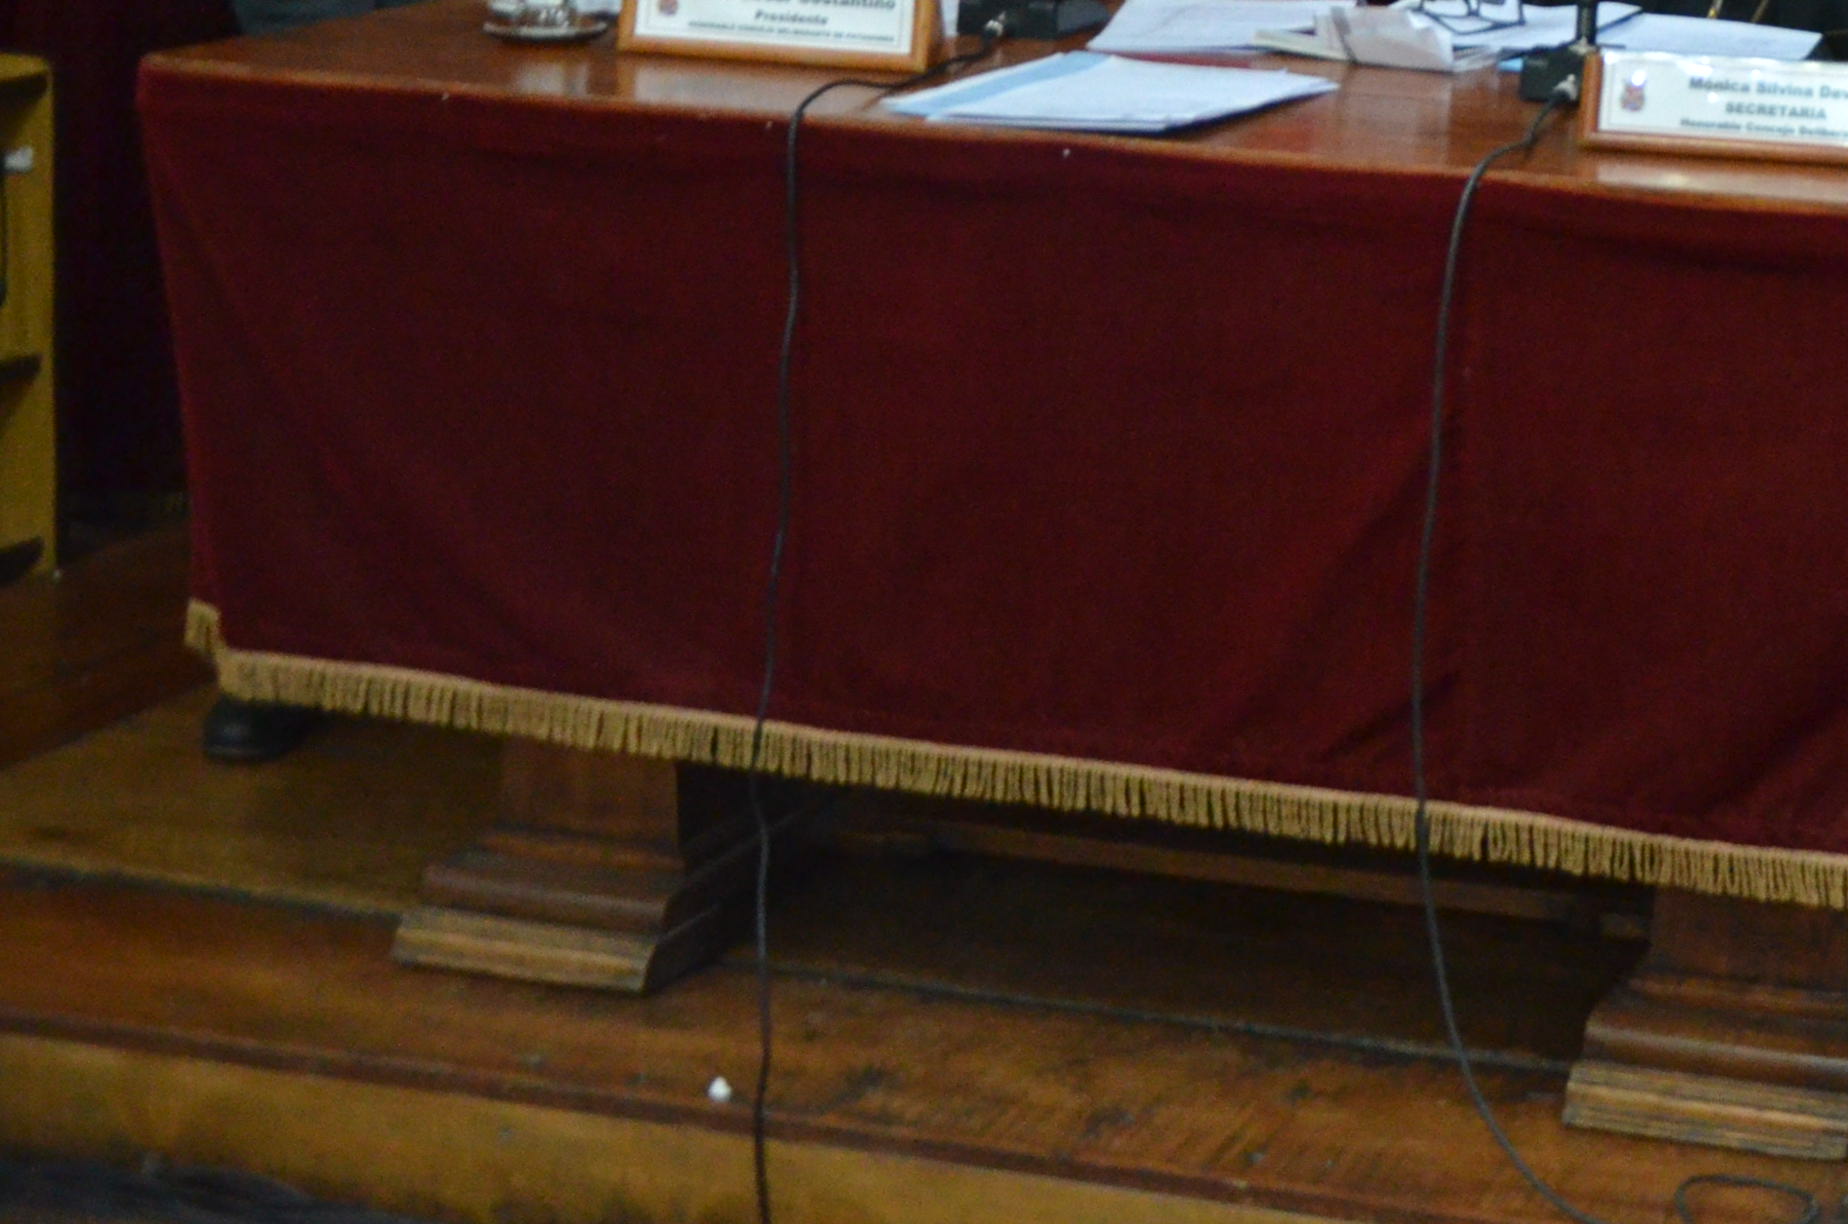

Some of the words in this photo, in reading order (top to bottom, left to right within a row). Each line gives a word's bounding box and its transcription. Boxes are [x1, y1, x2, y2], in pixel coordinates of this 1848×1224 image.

[754, 9, 829, 25] Presidente
[1756, 79, 1813, 98] Silvina
[1725, 102, 1827, 120] SECRETARIA
